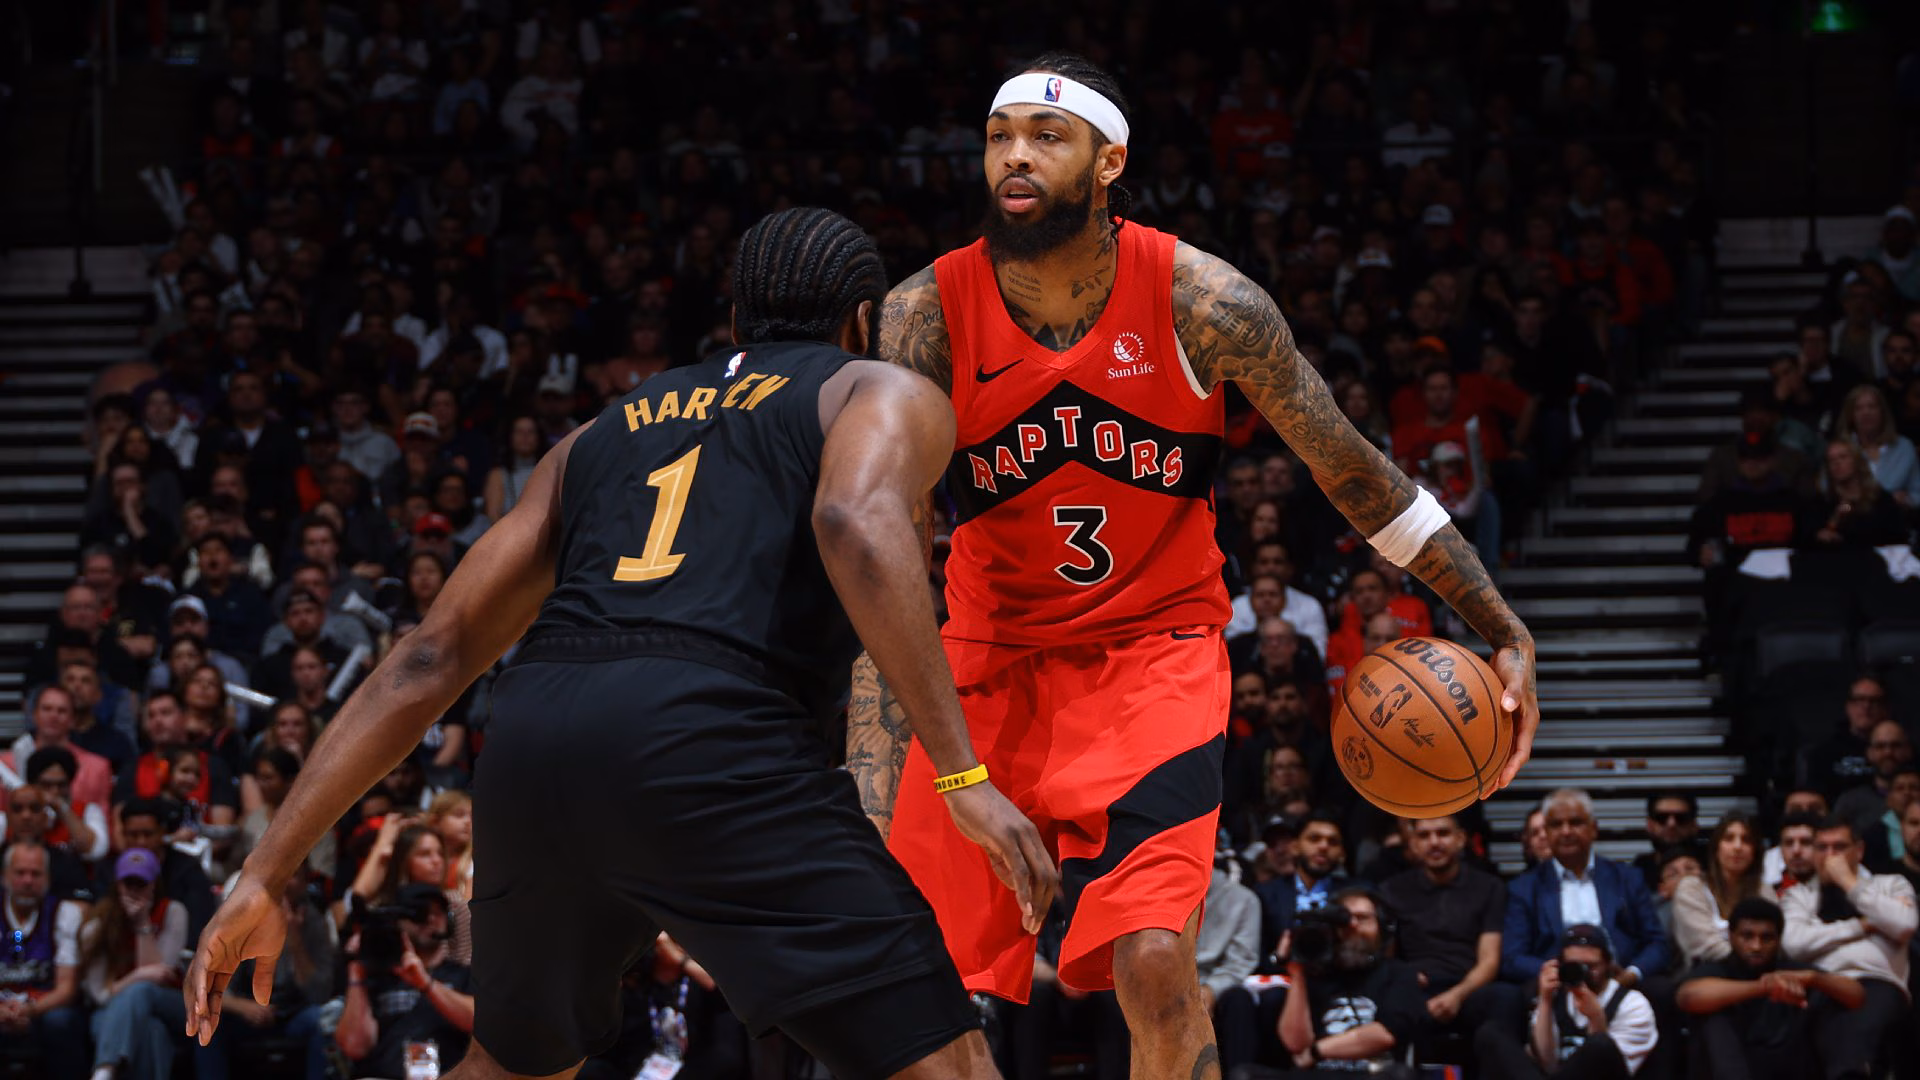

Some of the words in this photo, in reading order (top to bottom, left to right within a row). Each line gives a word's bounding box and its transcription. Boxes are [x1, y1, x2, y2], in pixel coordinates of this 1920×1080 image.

[624, 373, 790, 433] HAREN
[1108, 367, 1131, 379] Sun
[1132, 361, 1155, 375] Life
[968, 405, 1183, 494] RAPTORS
[613, 444, 702, 582] 1
[1053, 505, 1114, 586] 3
[1394, 637, 1479, 725] Wilson
